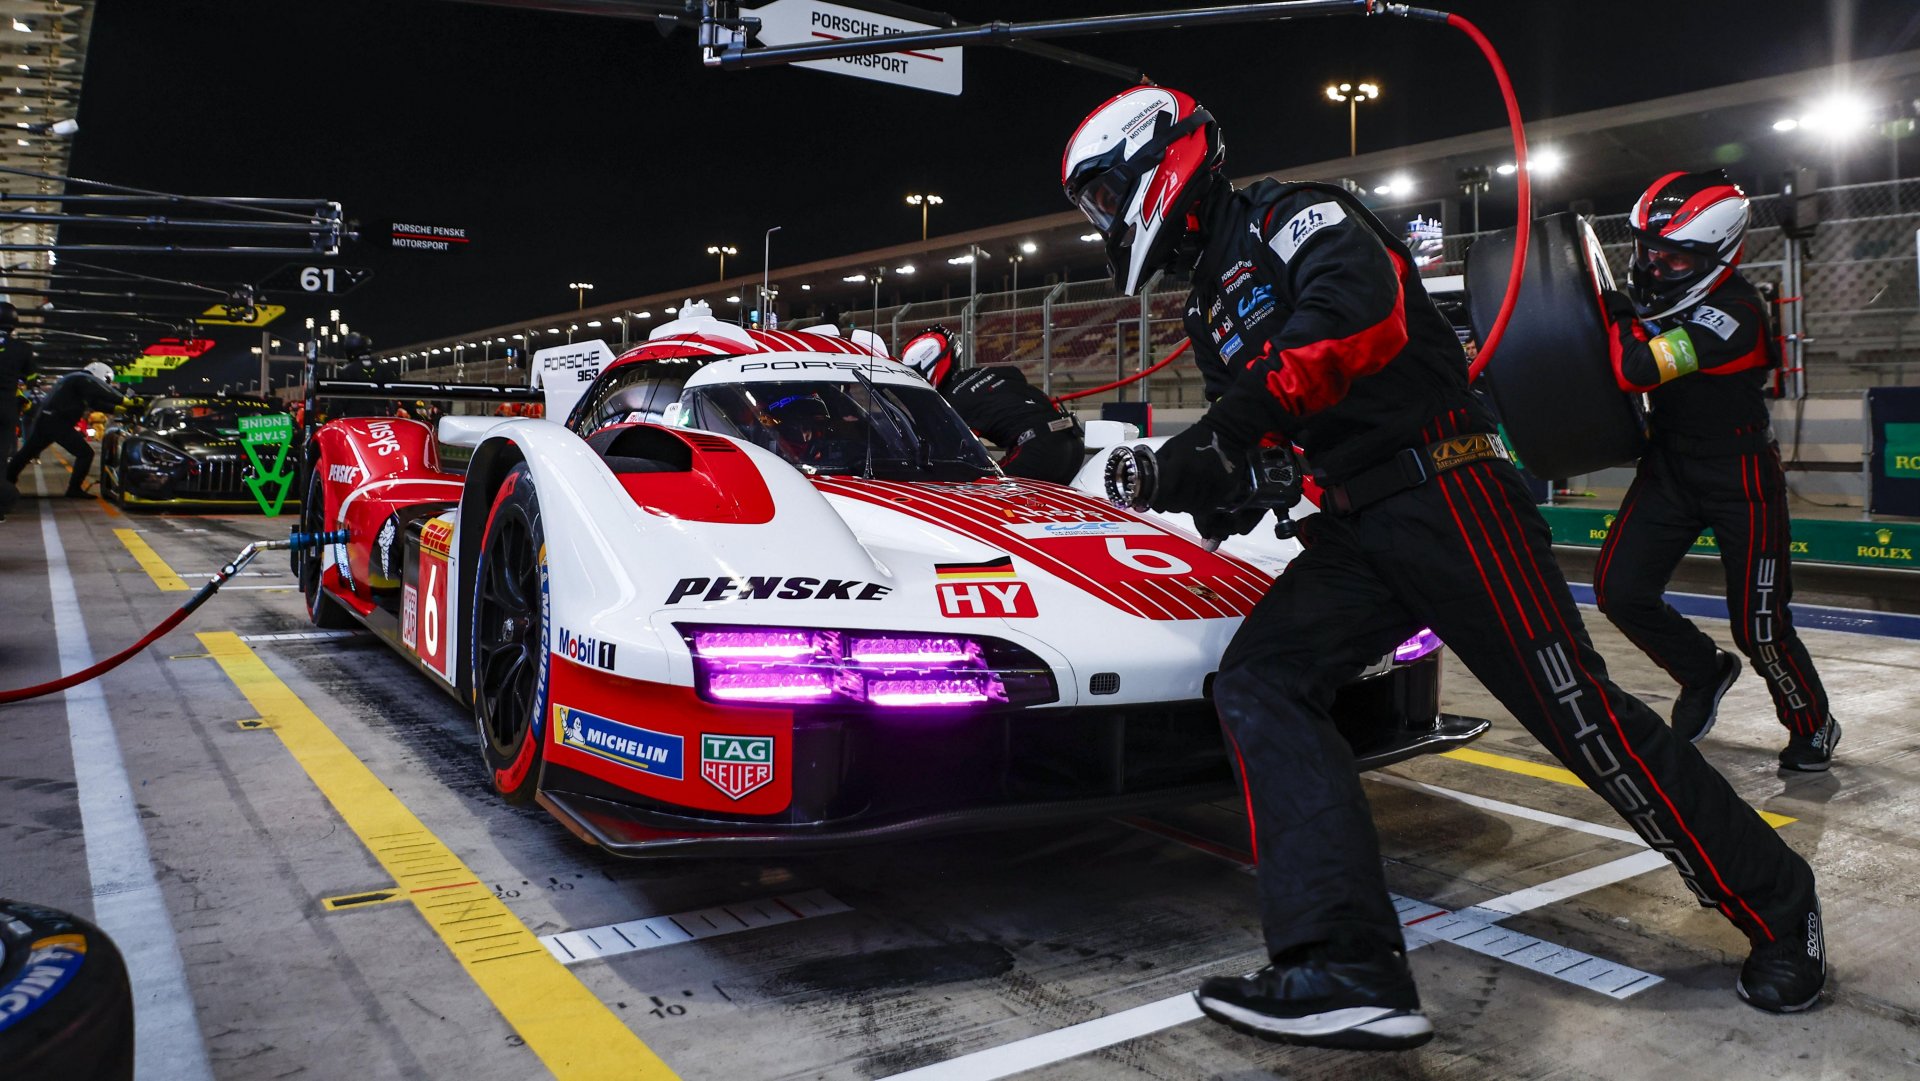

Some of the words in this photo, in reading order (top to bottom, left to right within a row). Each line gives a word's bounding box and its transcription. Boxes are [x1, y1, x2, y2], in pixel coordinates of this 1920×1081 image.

[811, 11, 879, 37] PORSCHE
[1121, 111, 1145, 132] PORSCHE
[1143, 99, 1163, 114] PENSKE
[392, 223, 431, 234] PORSCHE
[433, 227, 465, 237] PENSKE
[392, 238, 448, 250] MOTORSPORT
[301, 267, 335, 293] 61
[544, 351, 600, 371] PORSCHE
[740, 361, 924, 381] PORSCHE
[578, 368, 599, 382] 963
[237, 400, 270, 409] LYNX
[242, 416, 290, 429] ENGINE
[247, 431, 288, 442] START
[328, 464, 360, 484] PENSKE
[1105, 537, 1193, 575] 6
[1857, 546, 1912, 559] ROLEX
[664, 576, 893, 605] PENSKE
[941, 585, 1022, 614] HY
[425, 565, 438, 656] 6
[1755, 558, 1806, 710] PORSCHE
[534, 593, 549, 725] MICHELIN
[559, 627, 595, 666] Mobil
[601, 642, 613, 669] 1
[587, 727, 668, 763] MICHELIN
[707, 739, 766, 759] TAG
[706, 764, 767, 793] HEUER
[1807, 912, 1818, 958] sparco
[650, 1004, 686, 1019] 10
